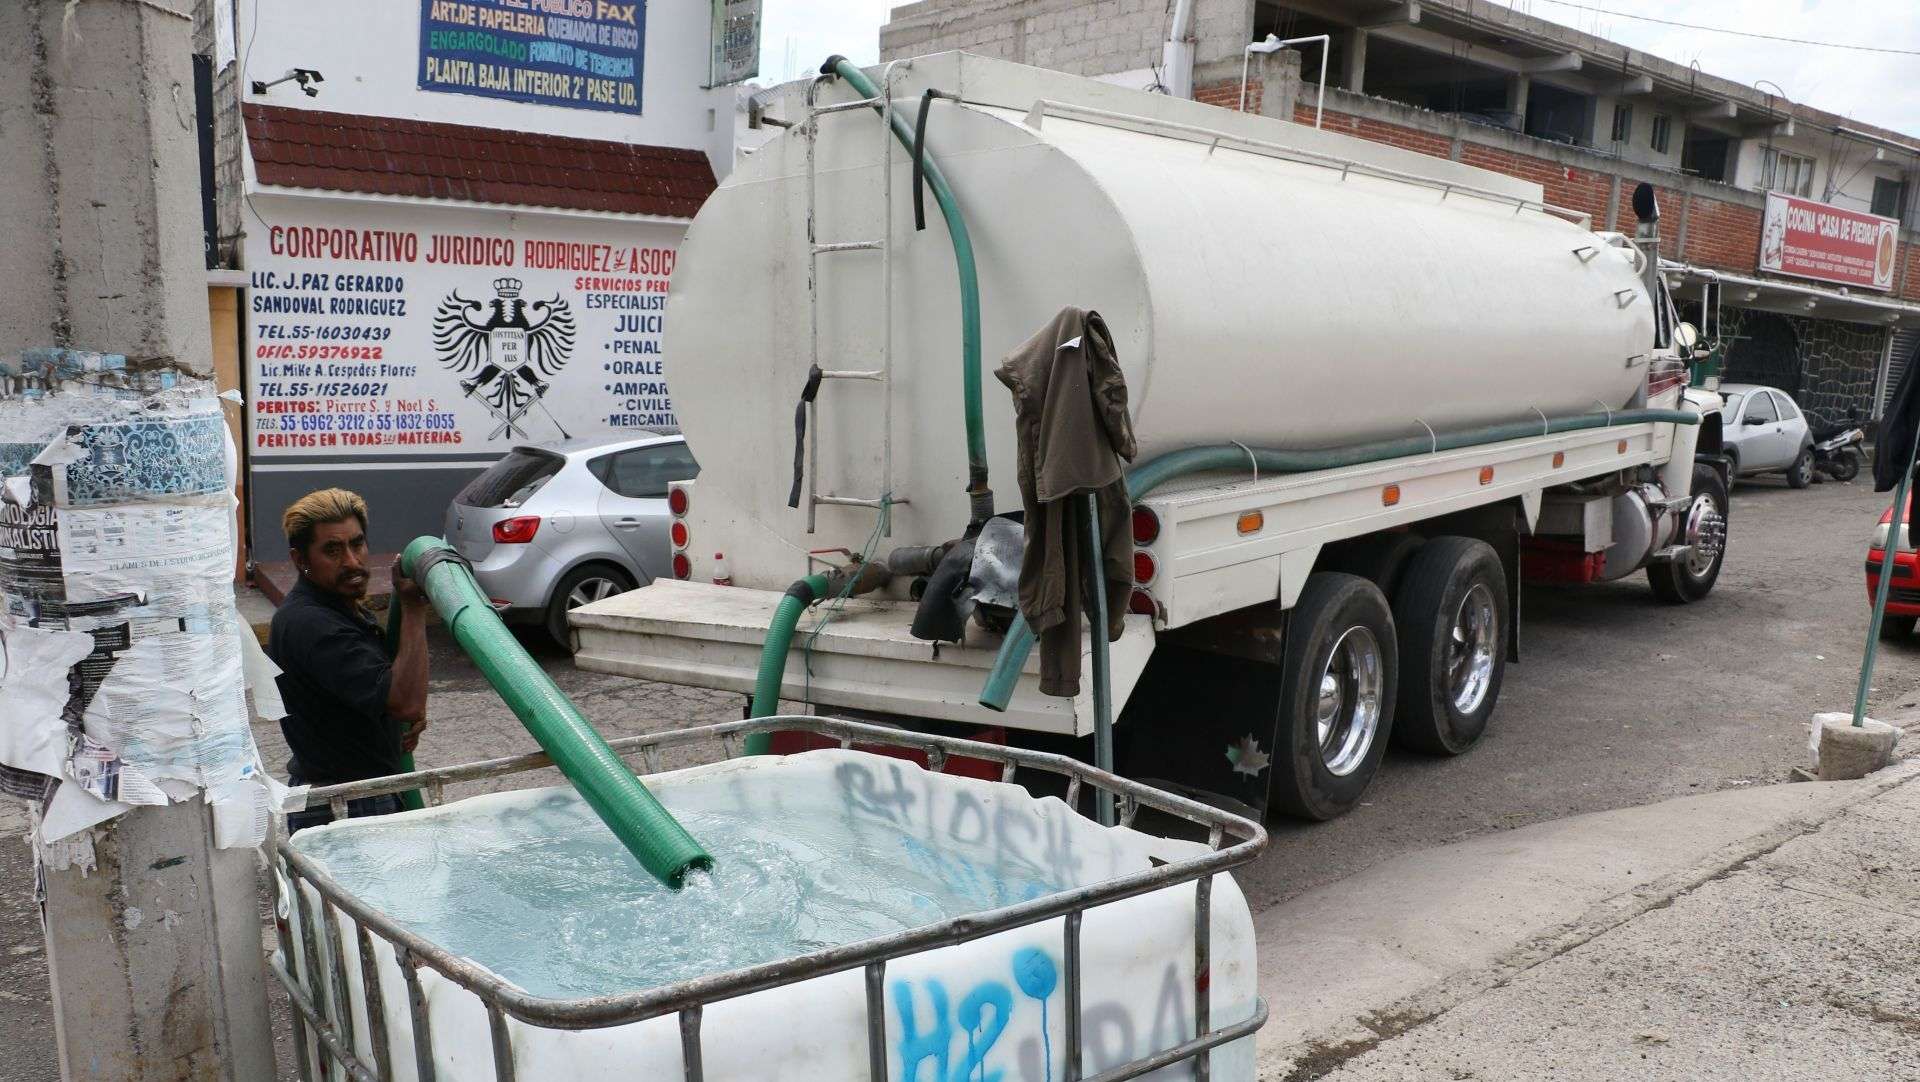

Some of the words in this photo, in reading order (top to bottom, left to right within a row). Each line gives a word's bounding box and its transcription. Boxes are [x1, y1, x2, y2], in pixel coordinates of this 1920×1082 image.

[597, 2, 636, 25] FAX
[479, 7, 546, 36] PAPELERIA
[598, 25, 611, 46] DE
[612, 27, 638, 50] DISCO
[430, 31, 526, 61] ENGARGOLADO
[426, 56, 475, 87] PLANTA
[479, 63, 510, 92] BAJA
[513, 68, 570, 99] INTERIOR
[587, 78, 616, 104] PASE
[1787, 206, 1816, 234] COCINA
[1841, 217, 1851, 240] DE
[269, 225, 418, 262] CORPORATIVO
[426, 234, 515, 266] JURIDICO
[524, 240, 612, 272] RODRIGUEZ
[335, 274, 404, 293] GERARDO
[575, 276, 641, 292] SERVICIOS
[253, 295, 325, 314] SANDOVAL
[330, 297, 406, 316] RODRIGUEZ
[586, 293, 666, 311] ESPECIALIST
[614, 315, 663, 333] JUICI
[502, 342, 517, 350] PER
[328, 363, 377, 379] Cespedes
[380, 364, 416, 377] Flores
[256, 400, 320, 414] PERITOS:
[326, 400, 366, 413] Pierre
[397, 399, 423, 413] Noel
[257, 434, 316, 448] PERITOS
[320, 433, 337, 447] EN
[341, 432, 382, 446] TODAS
[398, 431, 462, 445] MATERIAS
